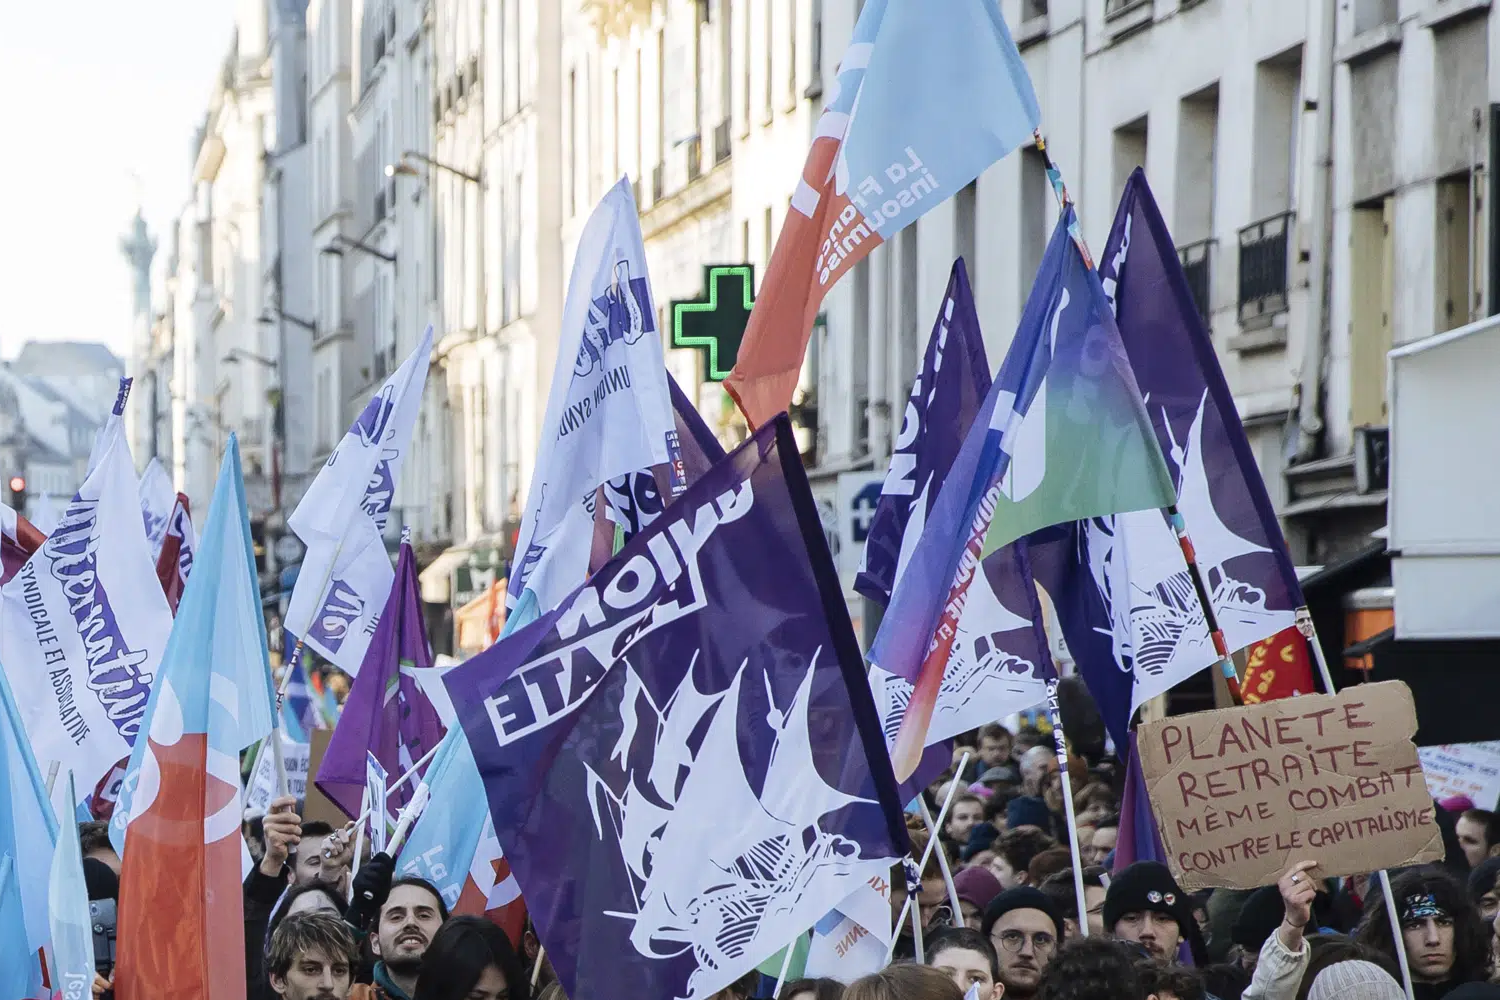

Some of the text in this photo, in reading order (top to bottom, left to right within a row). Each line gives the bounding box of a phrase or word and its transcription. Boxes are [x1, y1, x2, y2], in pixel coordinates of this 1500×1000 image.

[21, 560, 51, 646] SYNDICALE
[44, 646, 59, 667] ET
[1160, 702, 1375, 765] PLANETE
[1176, 801, 1275, 839] MÊME
[1288, 764, 1423, 811] COMBAT
